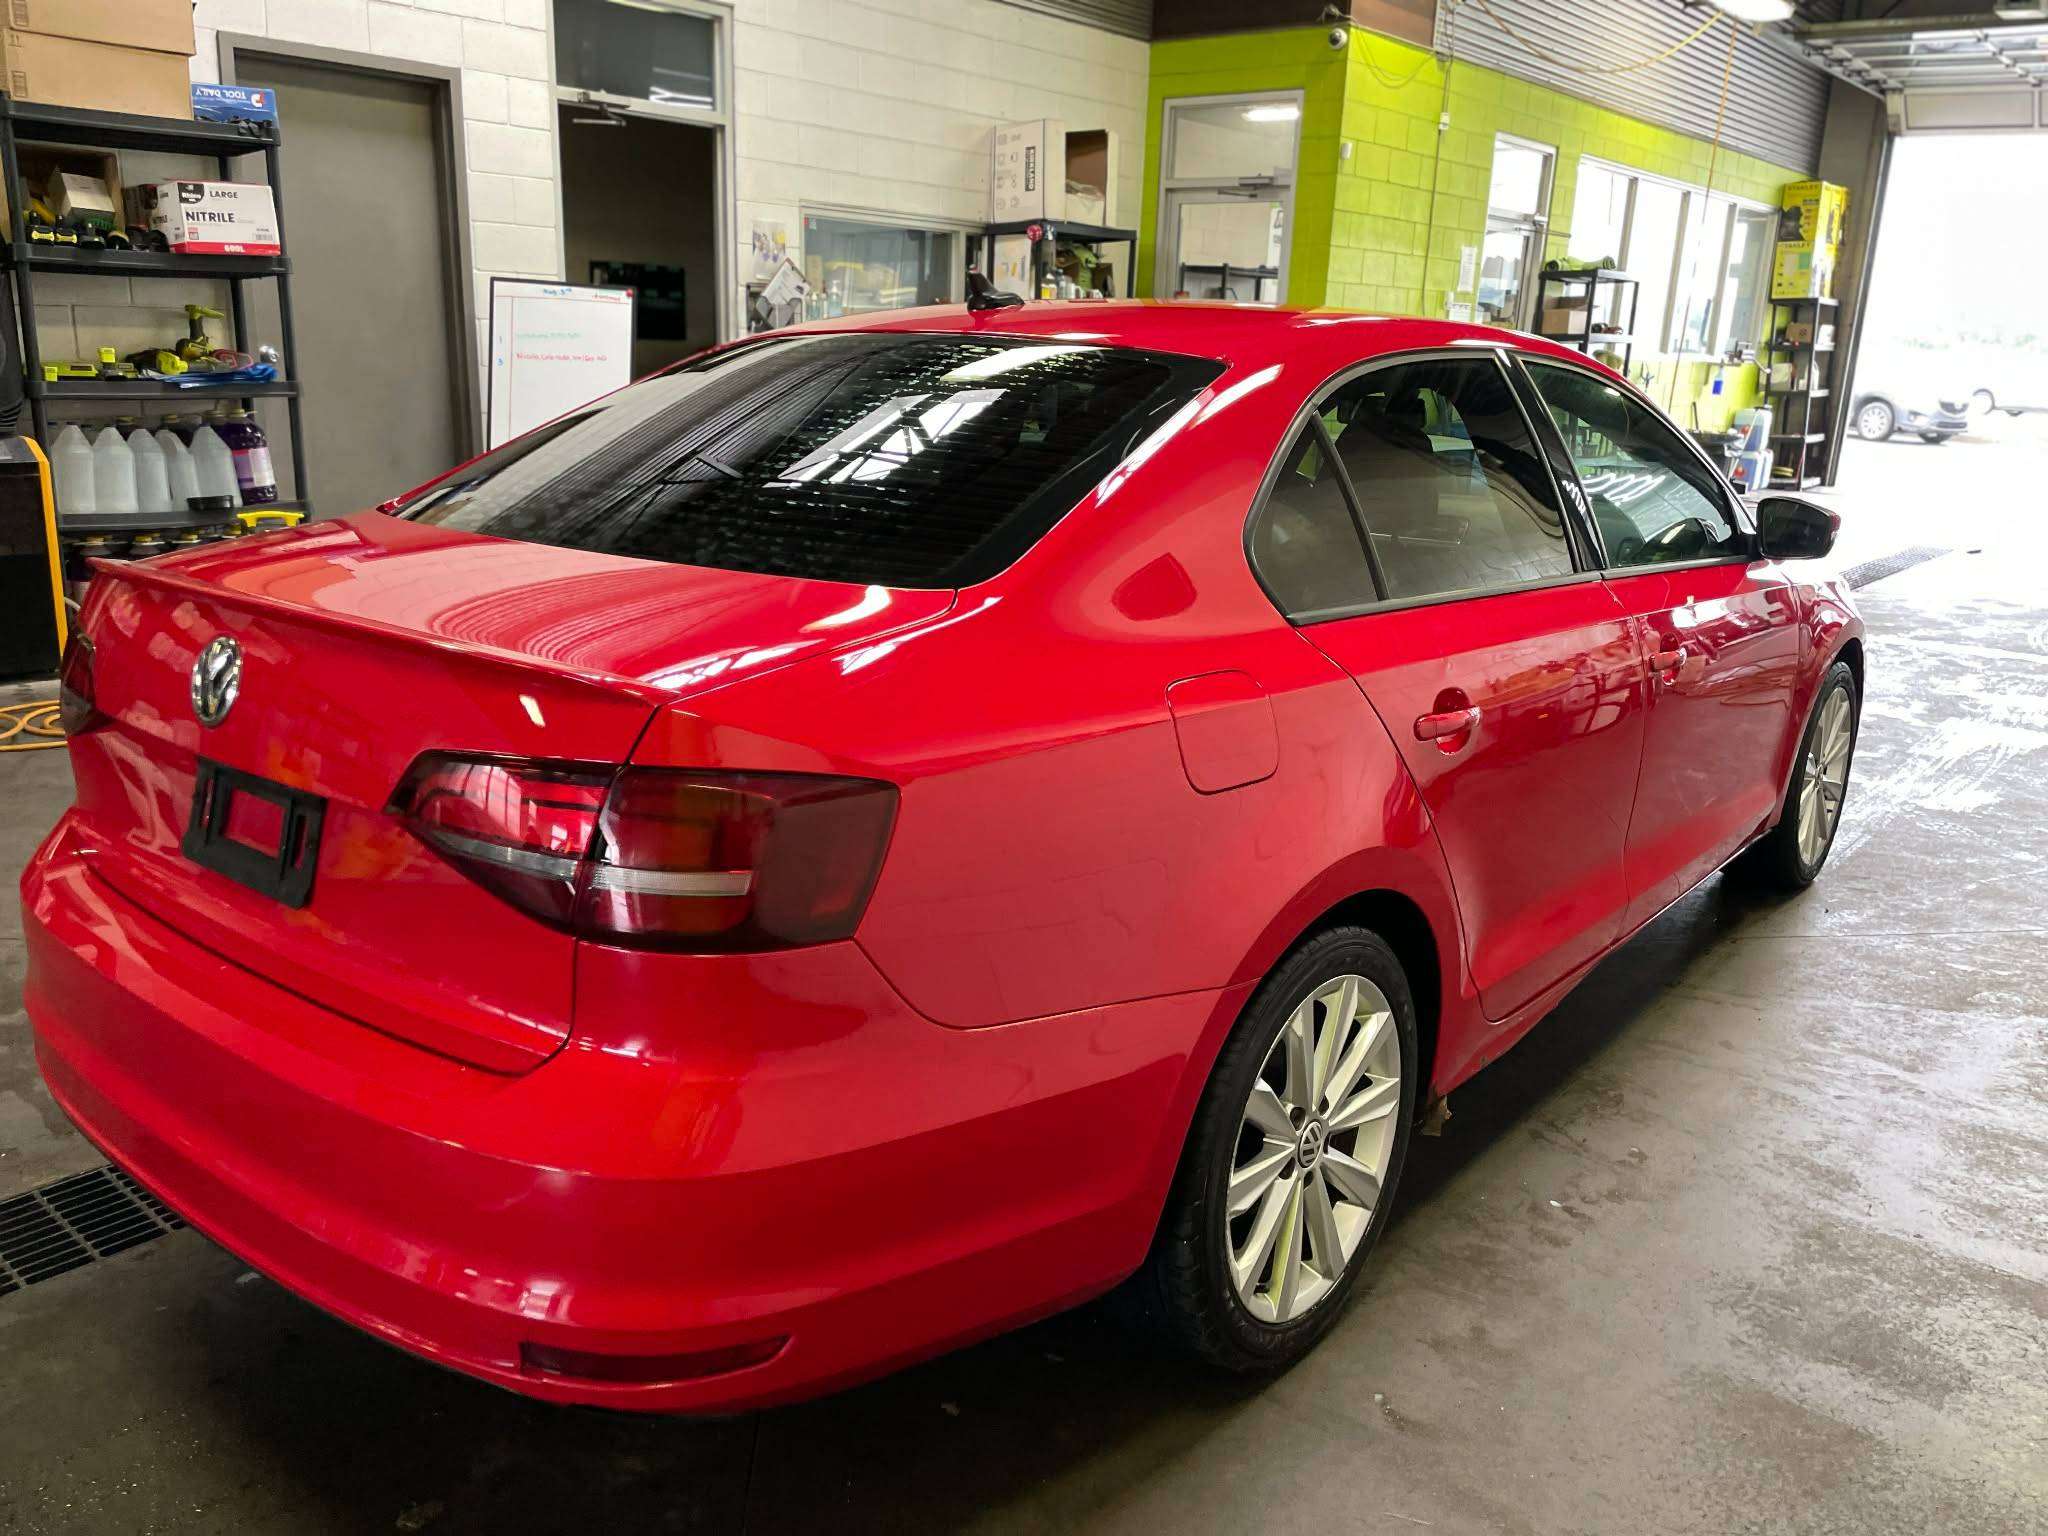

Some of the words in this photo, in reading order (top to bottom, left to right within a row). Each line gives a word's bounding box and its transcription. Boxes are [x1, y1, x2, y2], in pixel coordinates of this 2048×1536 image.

[195, 87, 221, 98] DAILY
[222, 90, 247, 100] TOOL
[209, 190, 239, 199] LARGE
[185, 211, 236, 224] NITRILE
